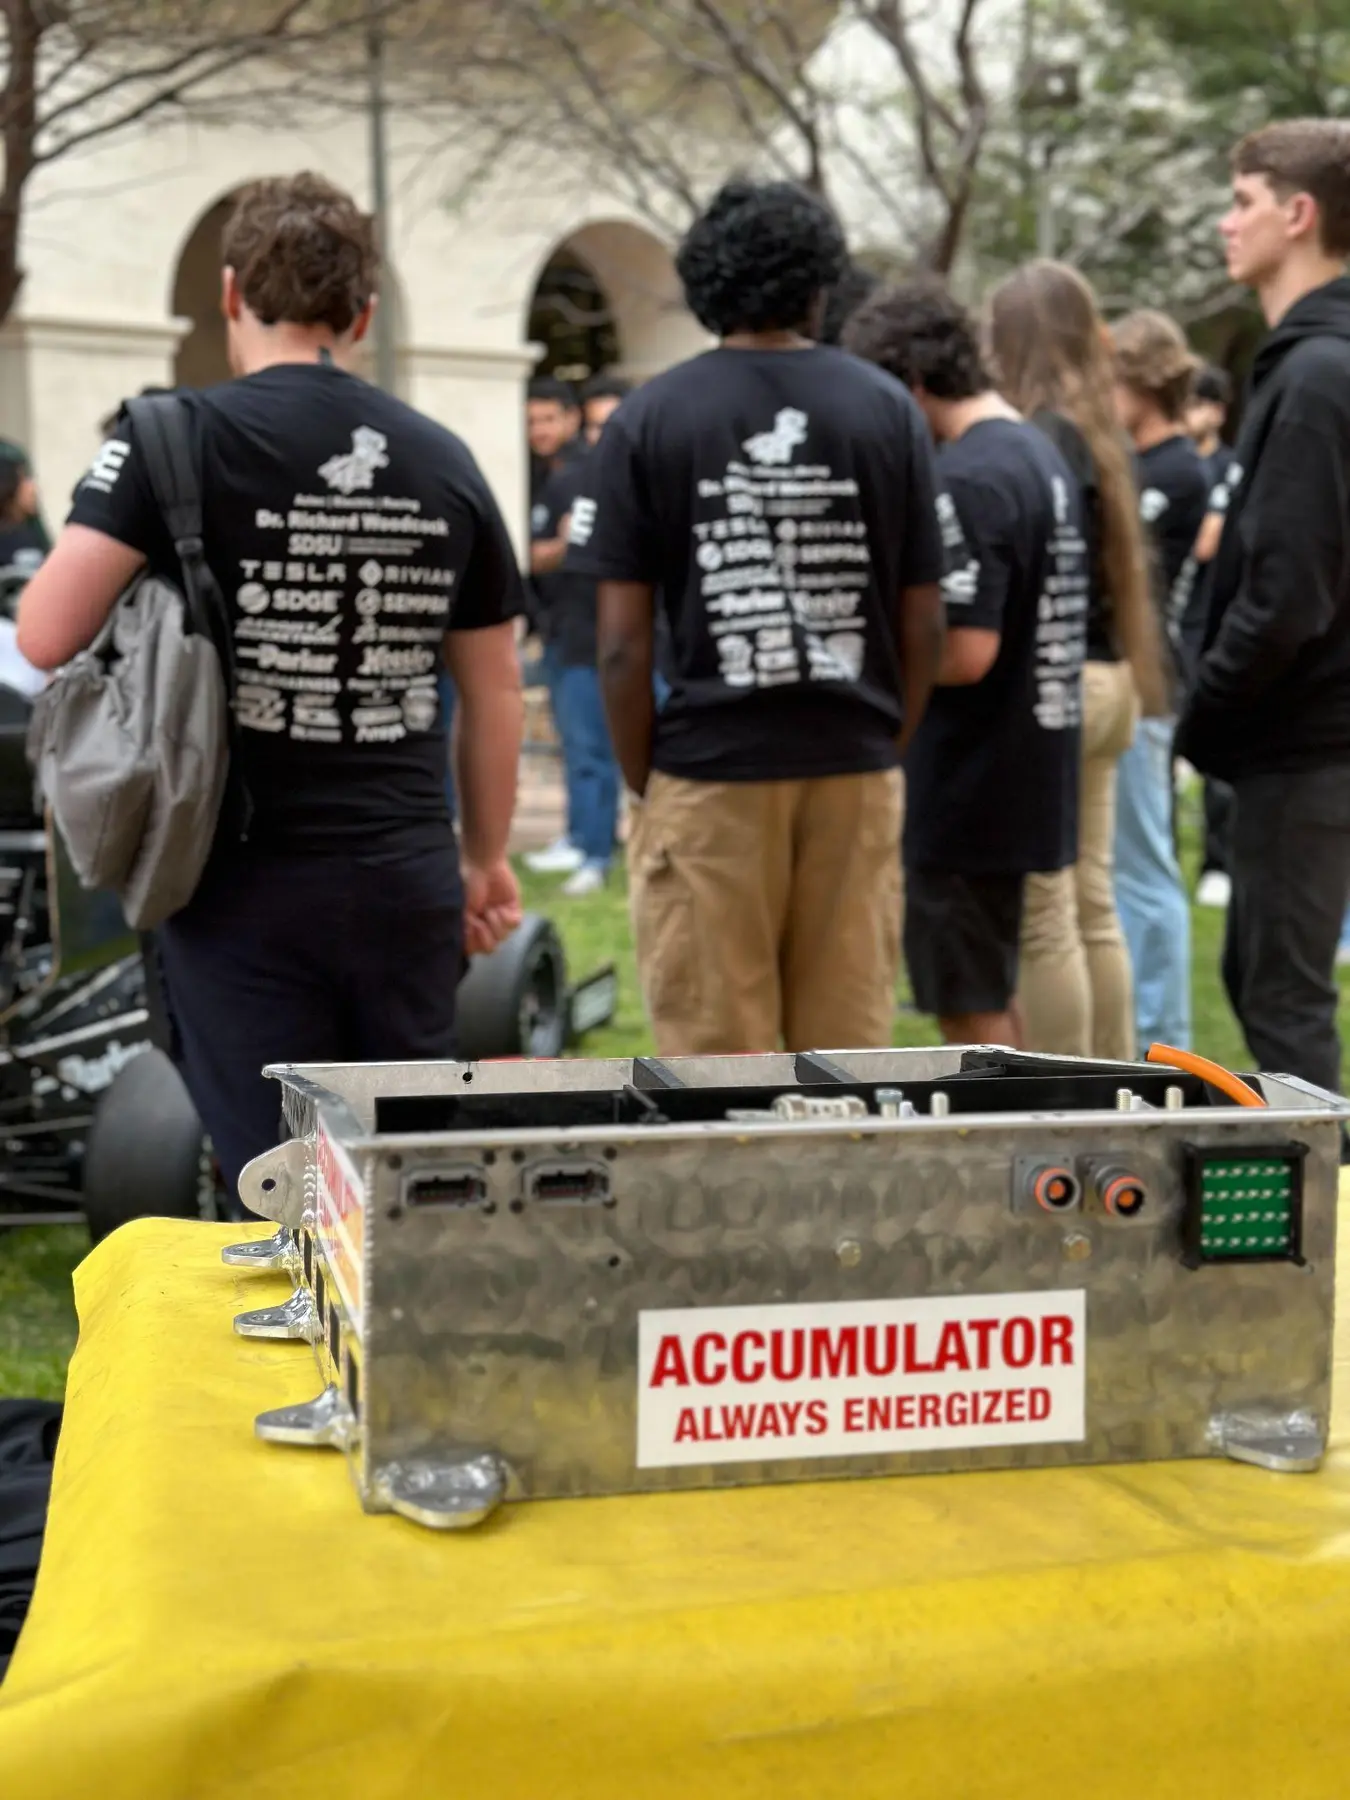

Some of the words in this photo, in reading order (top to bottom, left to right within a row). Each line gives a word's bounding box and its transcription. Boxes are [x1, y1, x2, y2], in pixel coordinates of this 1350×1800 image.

[255, 509, 285, 529] Dr.
[288, 533, 342, 556] SDSU
[239, 559, 347, 583] TESLA
[649, 1314, 1075, 1388] ACCUMULATOR
[673, 1400, 828, 1444] ALWAYS
[843, 1386, 1052, 1434] ENERGIZED
